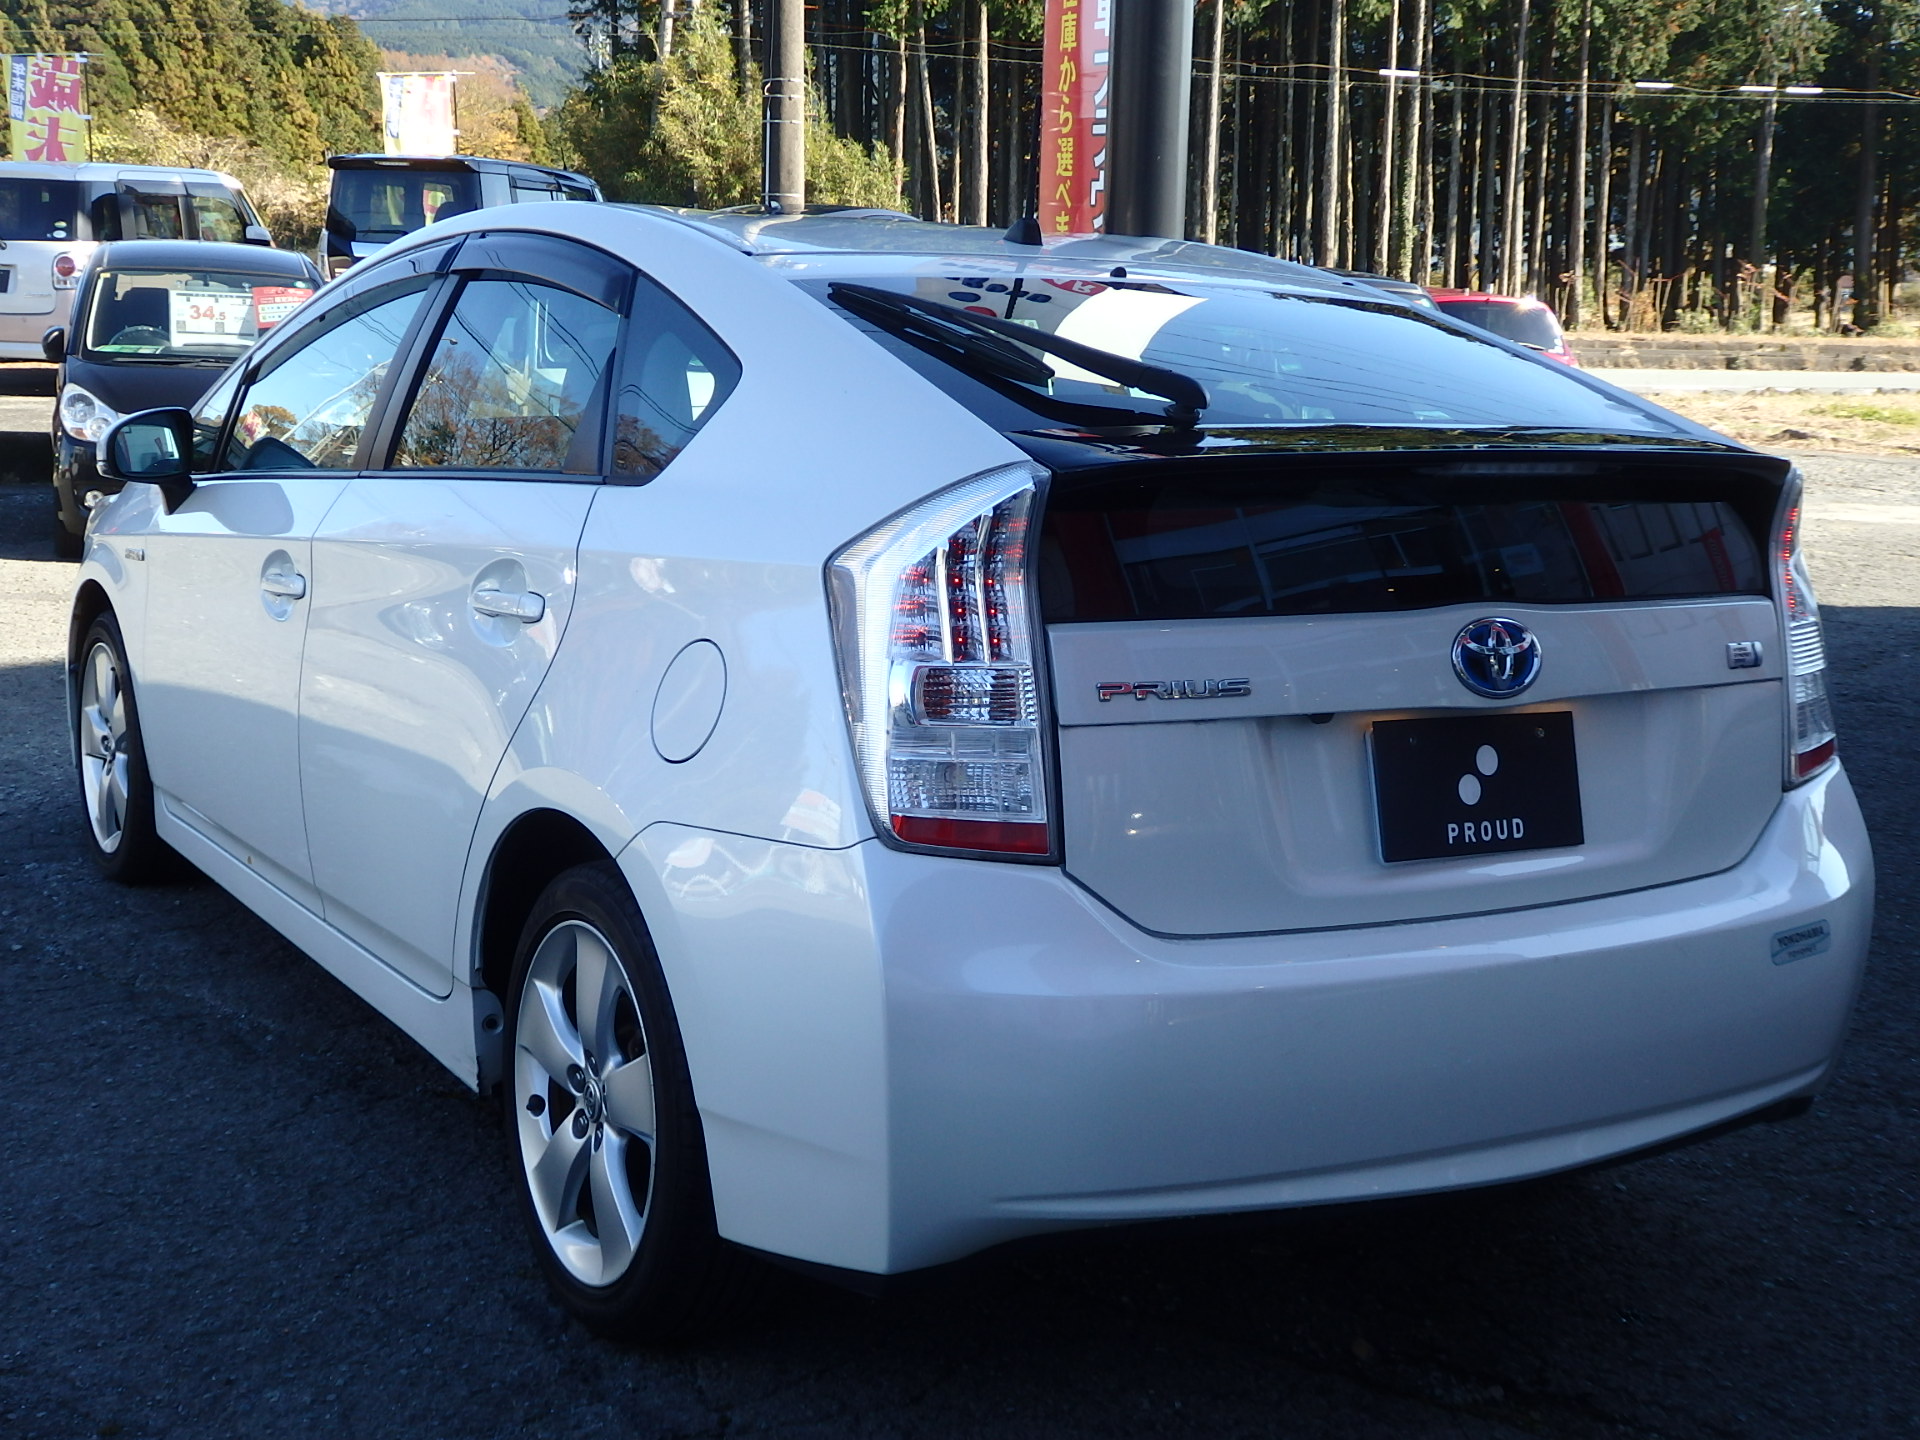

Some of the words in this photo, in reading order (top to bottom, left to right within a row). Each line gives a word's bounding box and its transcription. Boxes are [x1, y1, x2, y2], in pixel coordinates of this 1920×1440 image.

[1056, 0, 1077, 232] 庫から選べま
[1096, 678, 1251, 702] PRIUS
[1447, 817, 1524, 845] PROUD
